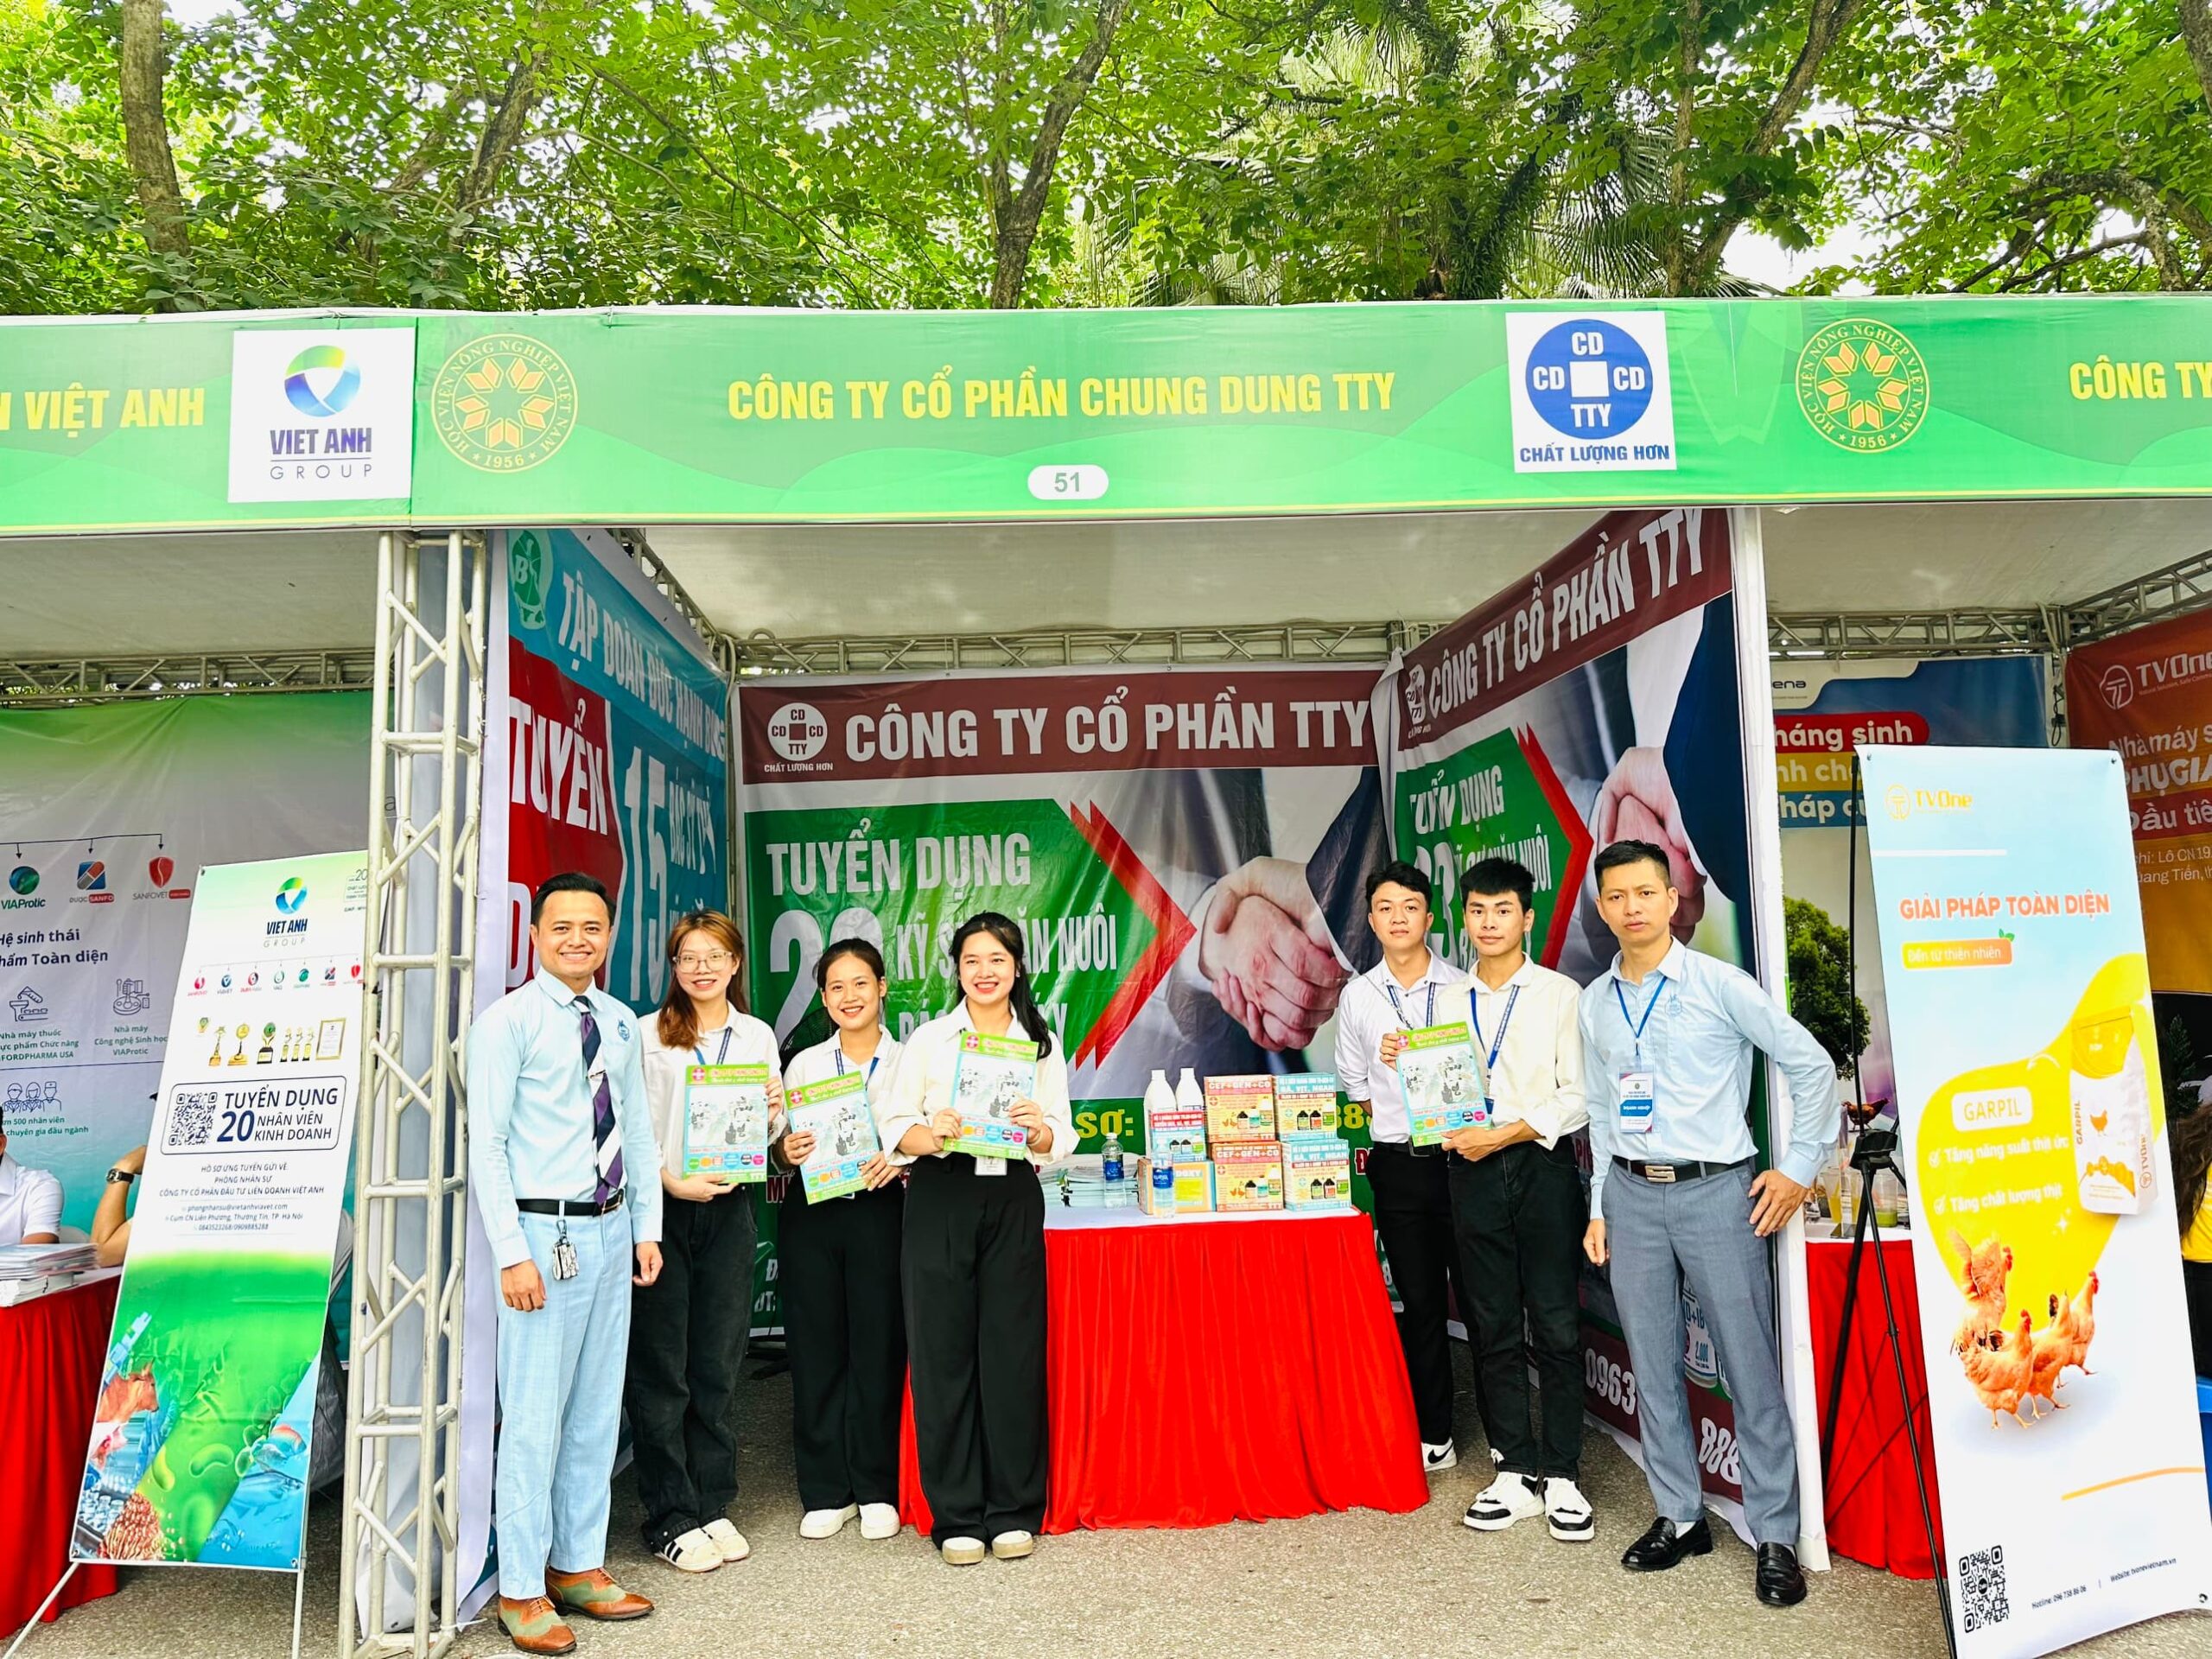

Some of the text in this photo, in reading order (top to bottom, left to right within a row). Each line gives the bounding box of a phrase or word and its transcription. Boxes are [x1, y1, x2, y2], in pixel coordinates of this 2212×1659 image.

[1571, 332, 1604, 356] CD
[1532, 366, 1646, 391] CD CD
[1802, 324, 1923, 434] HỌC VIỆN NÔNG NGHIỆP VIỆT NAM
[2069, 354, 2212, 400] CÔNG TY
[437, 340, 573, 454] HỌC VIỆN NÔNG NGHIỆP VIỆT NAM
[728, 365, 1396, 420] CÔNG TY CỔ PHẦN CHUNG DUNG TTY
[24, 382, 111, 439] VIỆT
[119, 387, 204, 428] ANH
[1570, 404, 1611, 428] TTY
[270, 427, 372, 455] VIET ANH
[1520, 442, 1670, 464] CHẤT LƯỢNG HƠN
[1850, 435, 1887, 448] 1956
[270, 463, 373, 480] GROUP
[484, 454, 524, 468] 1956
[1052, 471, 1081, 493] 51
[1429, 508, 1703, 719] CÔNG TY CỔ PHẦN TTY
[558, 570, 598, 671] TẬP
[603, 608, 645, 702] ĐOÀN
[790, 709, 805, 721] CD
[846, 686, 1370, 762] CÔNG TY CỔ PHẦN TTY
[772, 726, 823, 737] CD CD
[1852, 720, 1913, 745] sinh
[2149, 725, 2198, 753] máy
[788, 743, 808, 755] TTY
[764, 761, 785, 772] CHẤT
[816, 762, 834, 771] HƠN
[1459, 765, 1504, 832] DỤNG
[1914, 790, 1973, 809] TVOne
[766, 817, 901, 896] TUYỂN
[915, 833, 1032, 901] DỤNG
[2158, 848, 2196, 863] Lô CN
[624, 746, 667, 1004] 15
[1899, 889, 2110, 920] GIẢI PHÁP TOÀN DIỆN
[16, 928, 80, 944] sinh thái
[266, 918, 308, 935] VIET ANH
[264, 938, 306, 948] GROUP
[896, 906, 1118, 981] KỸ NUÔI
[31, 949, 108, 965] Toàn diện
[225, 1084, 338, 1111] TUYỂN DỤNG
[257, 1110, 323, 1127] NHÂN VIÊN
[1963, 1098, 2023, 1122] GARPIL
[217, 1109, 255, 1142] 20
[255, 1128, 332, 1141] KINH DOANH
[1585, 1348, 1637, 1415] 0963
